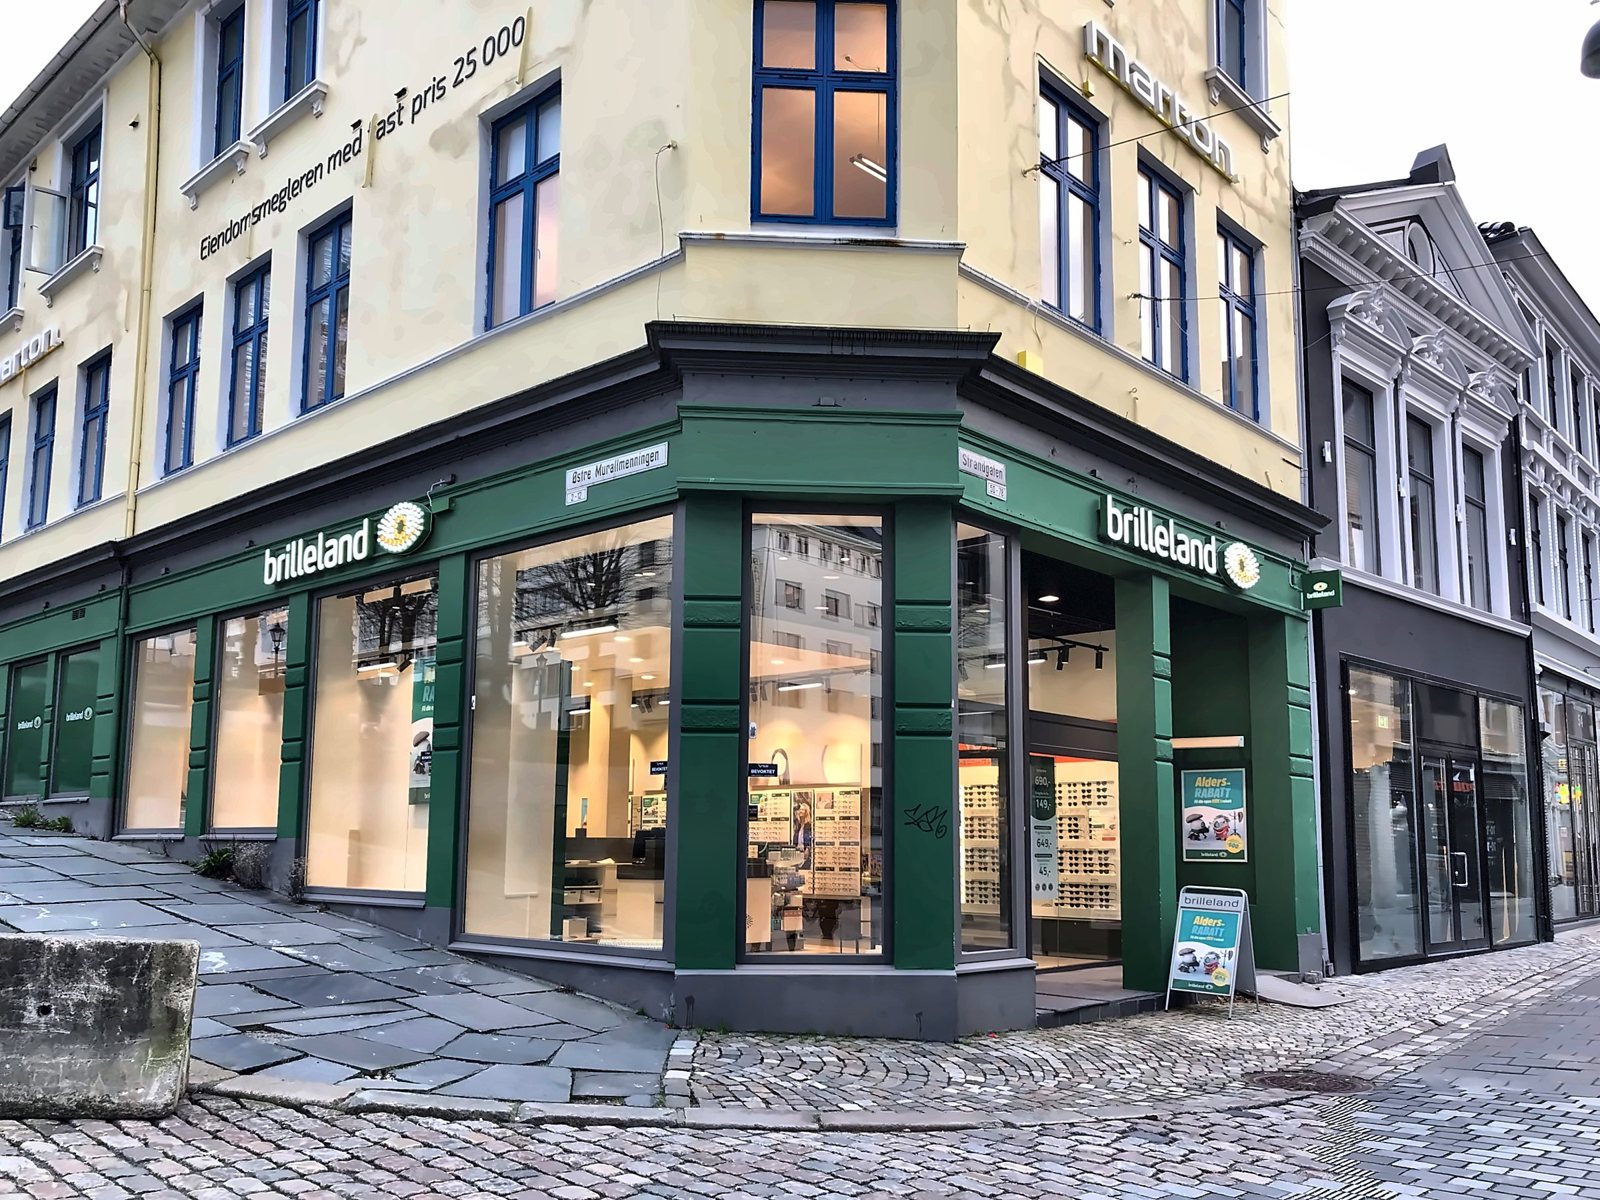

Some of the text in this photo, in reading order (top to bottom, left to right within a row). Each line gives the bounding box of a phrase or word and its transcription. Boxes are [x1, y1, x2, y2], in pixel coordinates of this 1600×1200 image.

[1085, 20, 1234, 178] marton
[200, 16, 525, 260] Eiendomsmegleren med ast pris 25 000
[572, 450, 660, 483] Østre Murallmenningen
[962, 454, 1003, 479] Strandgaten
[1107, 494, 1218, 575] brilleland
[263, 518, 369, 585] brilleland
[1306, 589, 1336, 599] brilleland
[65, 710, 84, 722] brilleland
[1195, 776, 1231, 787] Alders-
[1194, 787, 1232, 798] RABATT
[1184, 896, 1240, 908] brilleland
[1191, 925, 1225, 937] RABATT
